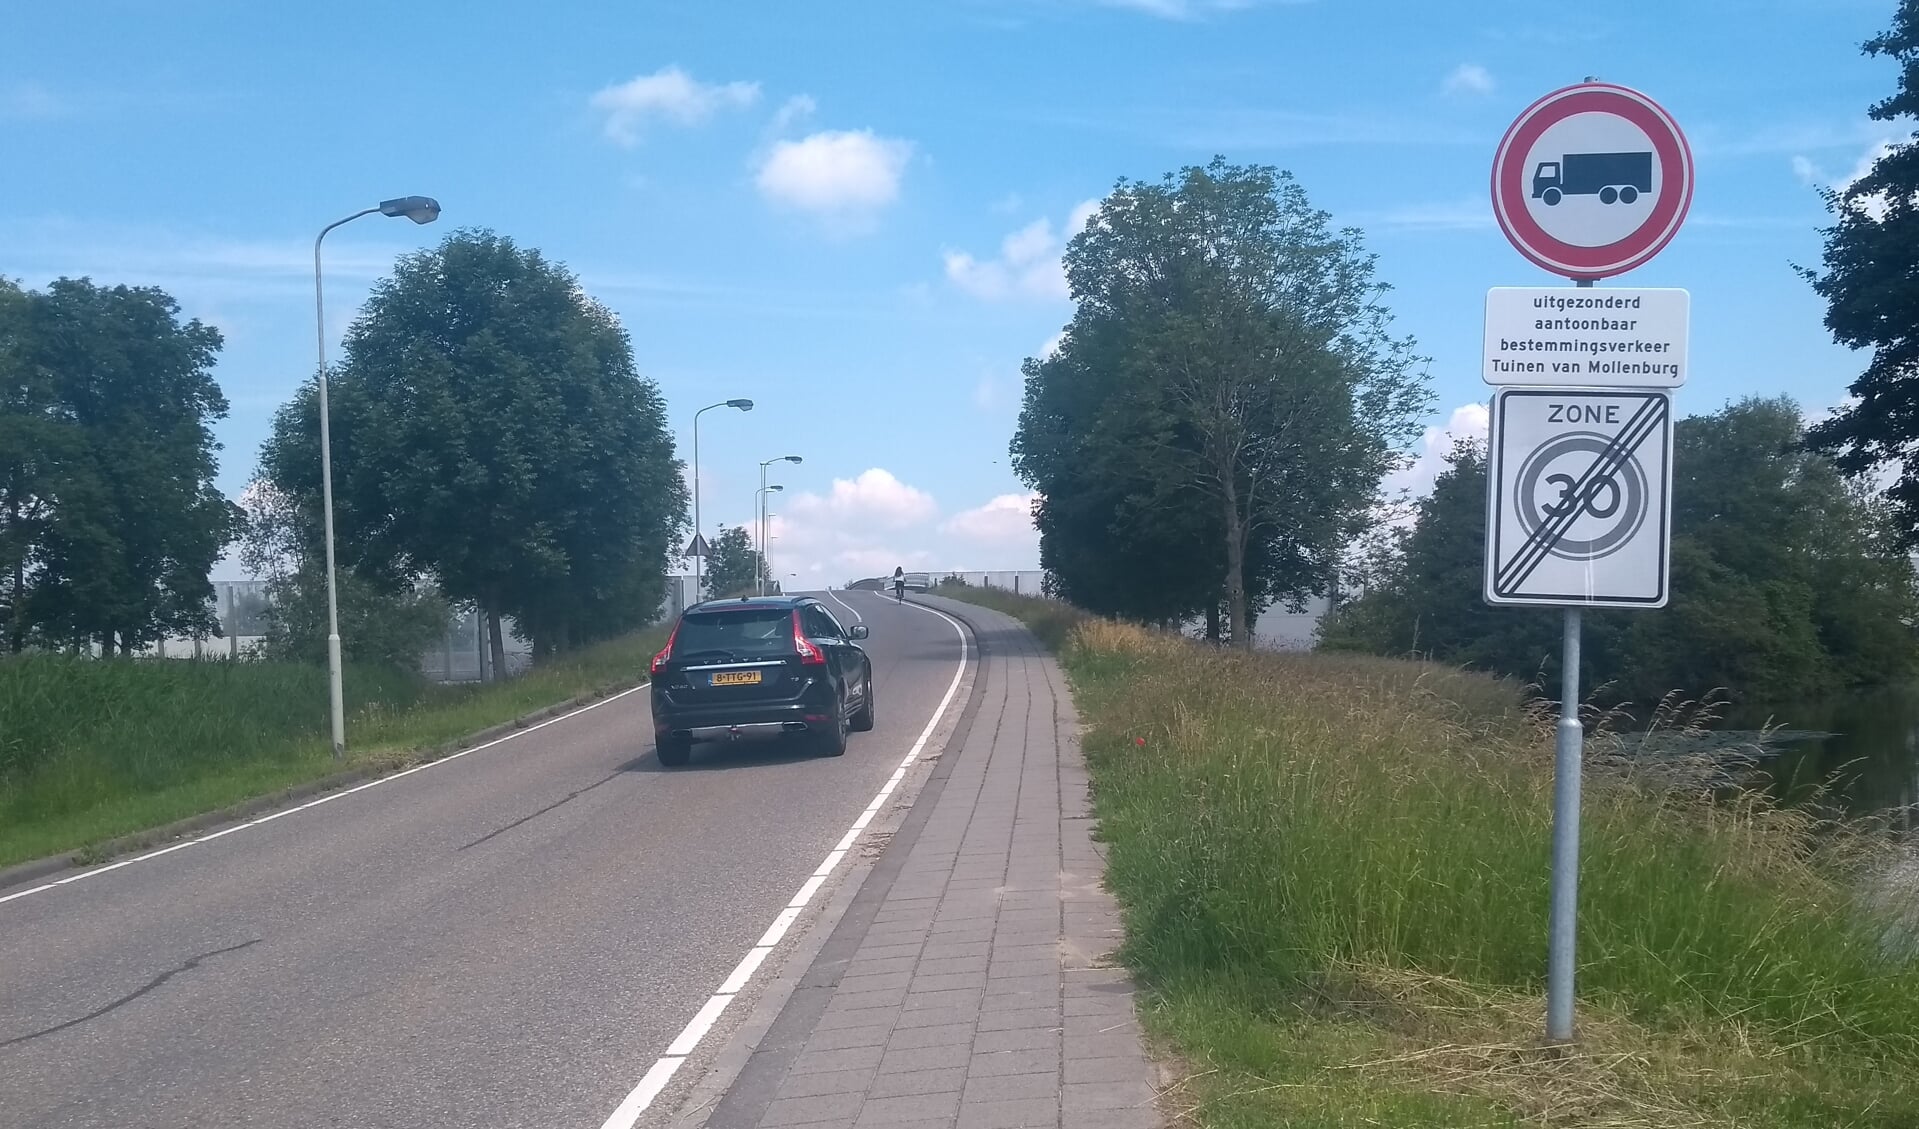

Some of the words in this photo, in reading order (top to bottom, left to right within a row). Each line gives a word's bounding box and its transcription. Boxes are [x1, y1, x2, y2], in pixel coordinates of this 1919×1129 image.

[1533, 295, 1640, 311] uitgezonderd
[1535, 317, 1637, 331] aantoonbaar
[1500, 338, 1670, 356] bestemmingsverkeer
[1492, 359, 1545, 373] Tuinen
[1552, 362, 1580, 373] van
[1588, 360, 1679, 378] Mollenburg
[1547, 404, 1620, 424] ZONE
[1541, 473, 1621, 519] 30
[716, 672, 756, 682] 8-TTG-91
